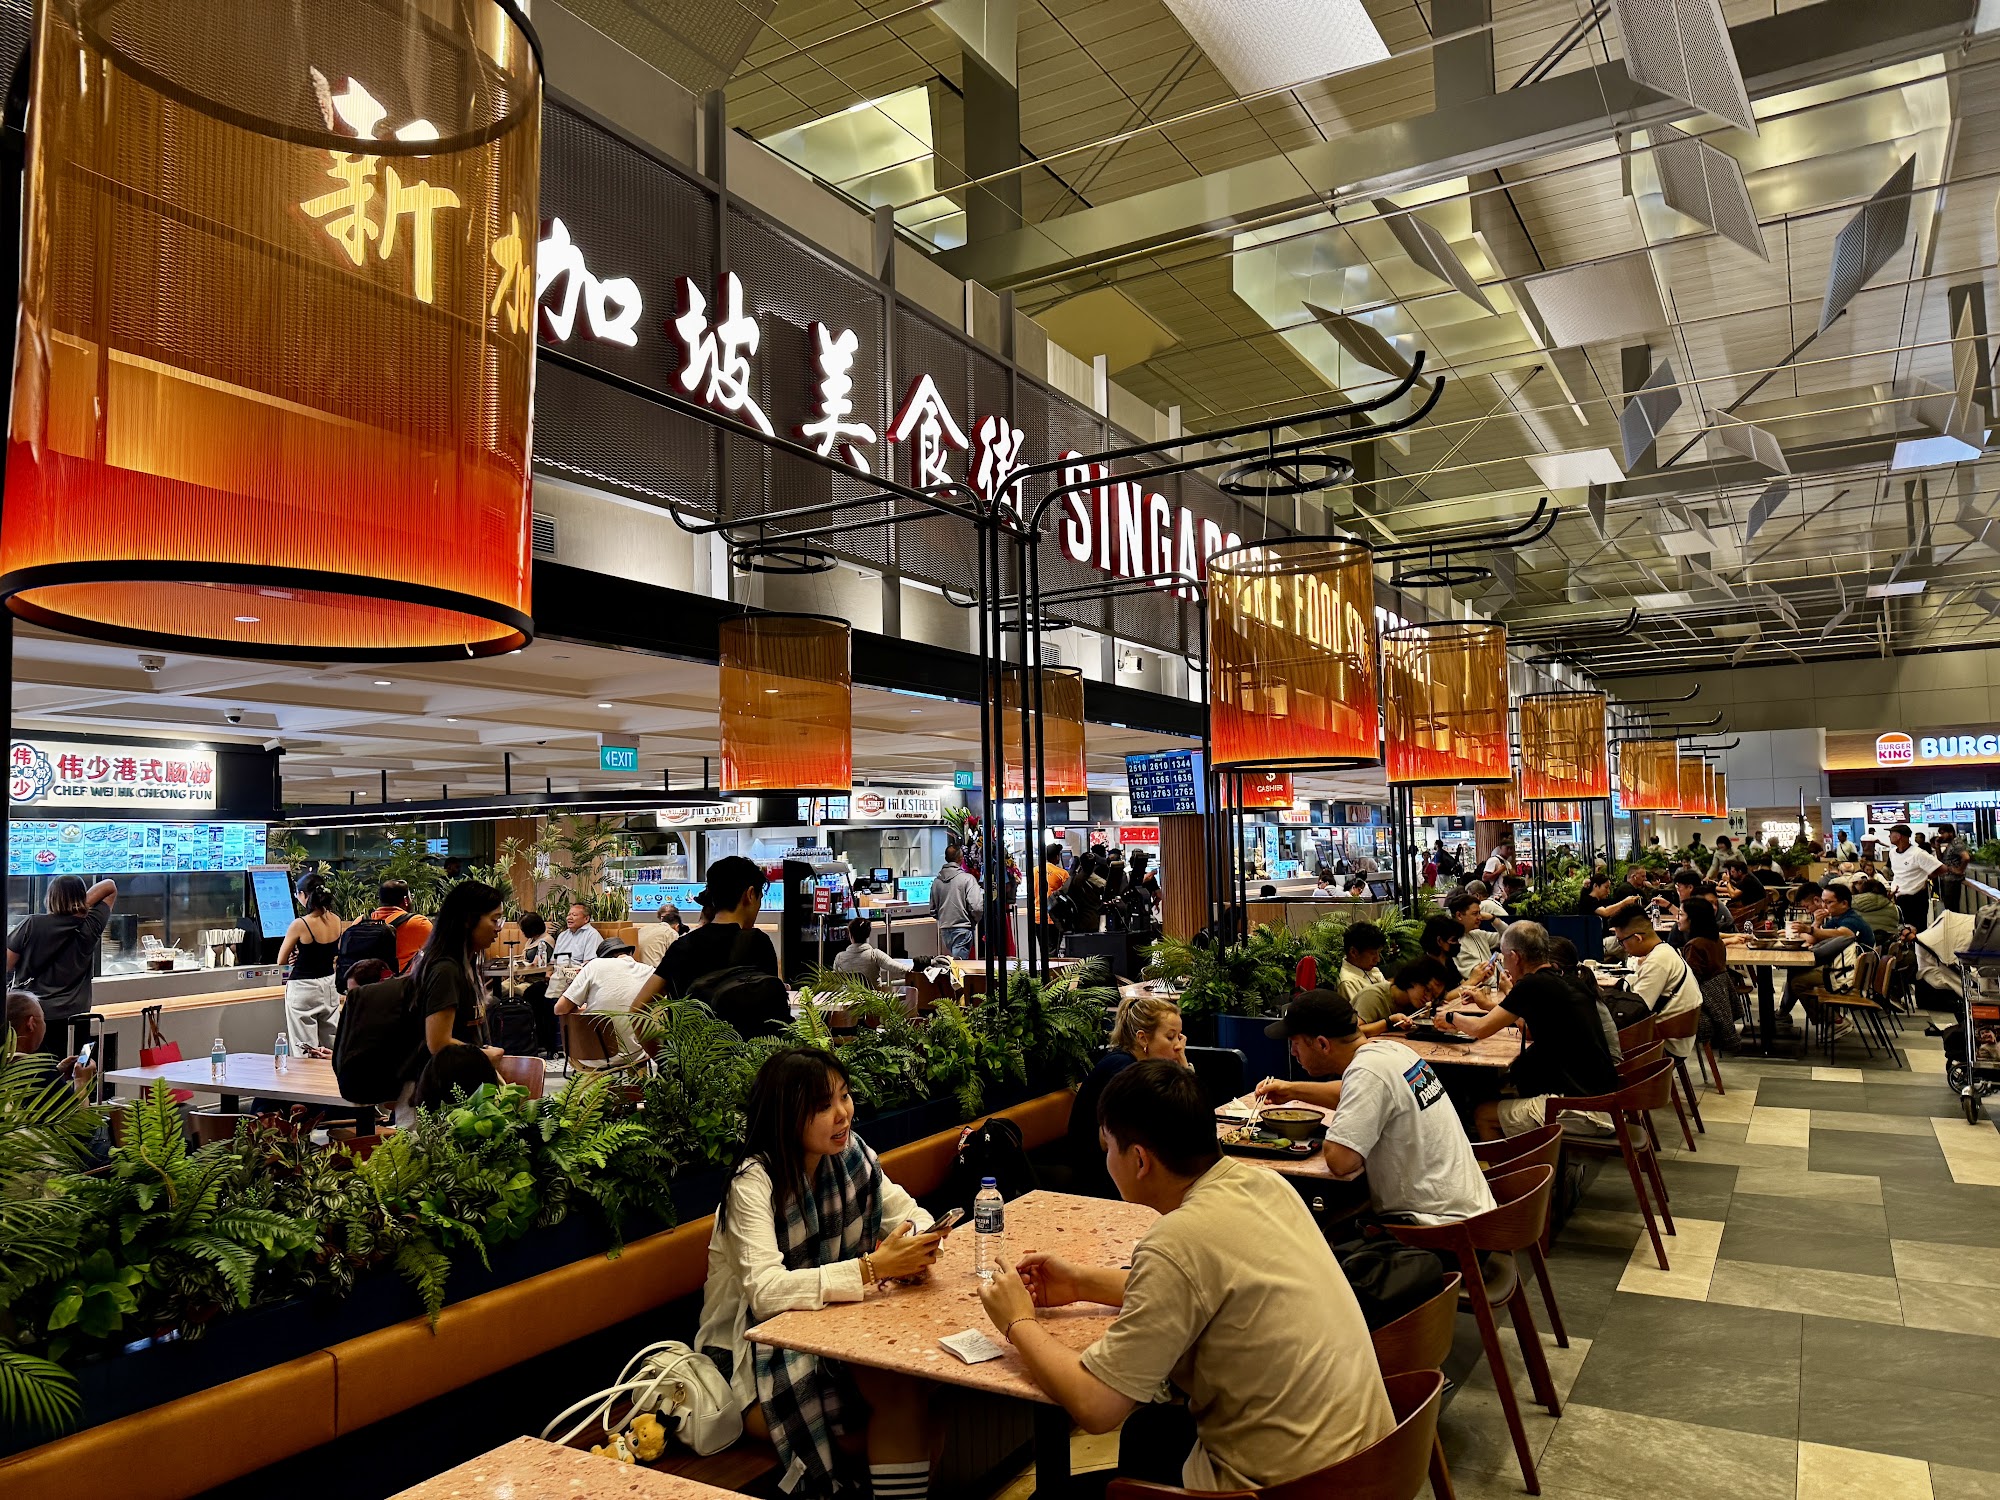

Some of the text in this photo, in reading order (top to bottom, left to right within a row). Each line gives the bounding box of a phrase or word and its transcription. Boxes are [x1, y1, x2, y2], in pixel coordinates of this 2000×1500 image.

[1921, 735, 2000, 758] BURG
[611, 751, 633, 767] EXIT
[1879, 750, 1911, 759] KING
[57, 754, 213, 784] 伟少港式肠粉
[1129, 760, 1191, 773] 2510 2610 1344
[956, 773, 968, 785] EXIT
[1131, 774, 1192, 786] 1478 1565 1636
[13, 779, 31, 796] 少
[53, 785, 213, 800] CHEF WEI HK CHEONG FUN
[1132, 788, 1194, 799] 1862 2763 2762
[1257, 784, 1284, 792] CASHIER
[908, 799, 939, 811] STREET
[1133, 801, 1195, 813] 2146 2391
[1956, 801, 1979, 809] HAVE
[1980, 801, 1990, 809] IT
